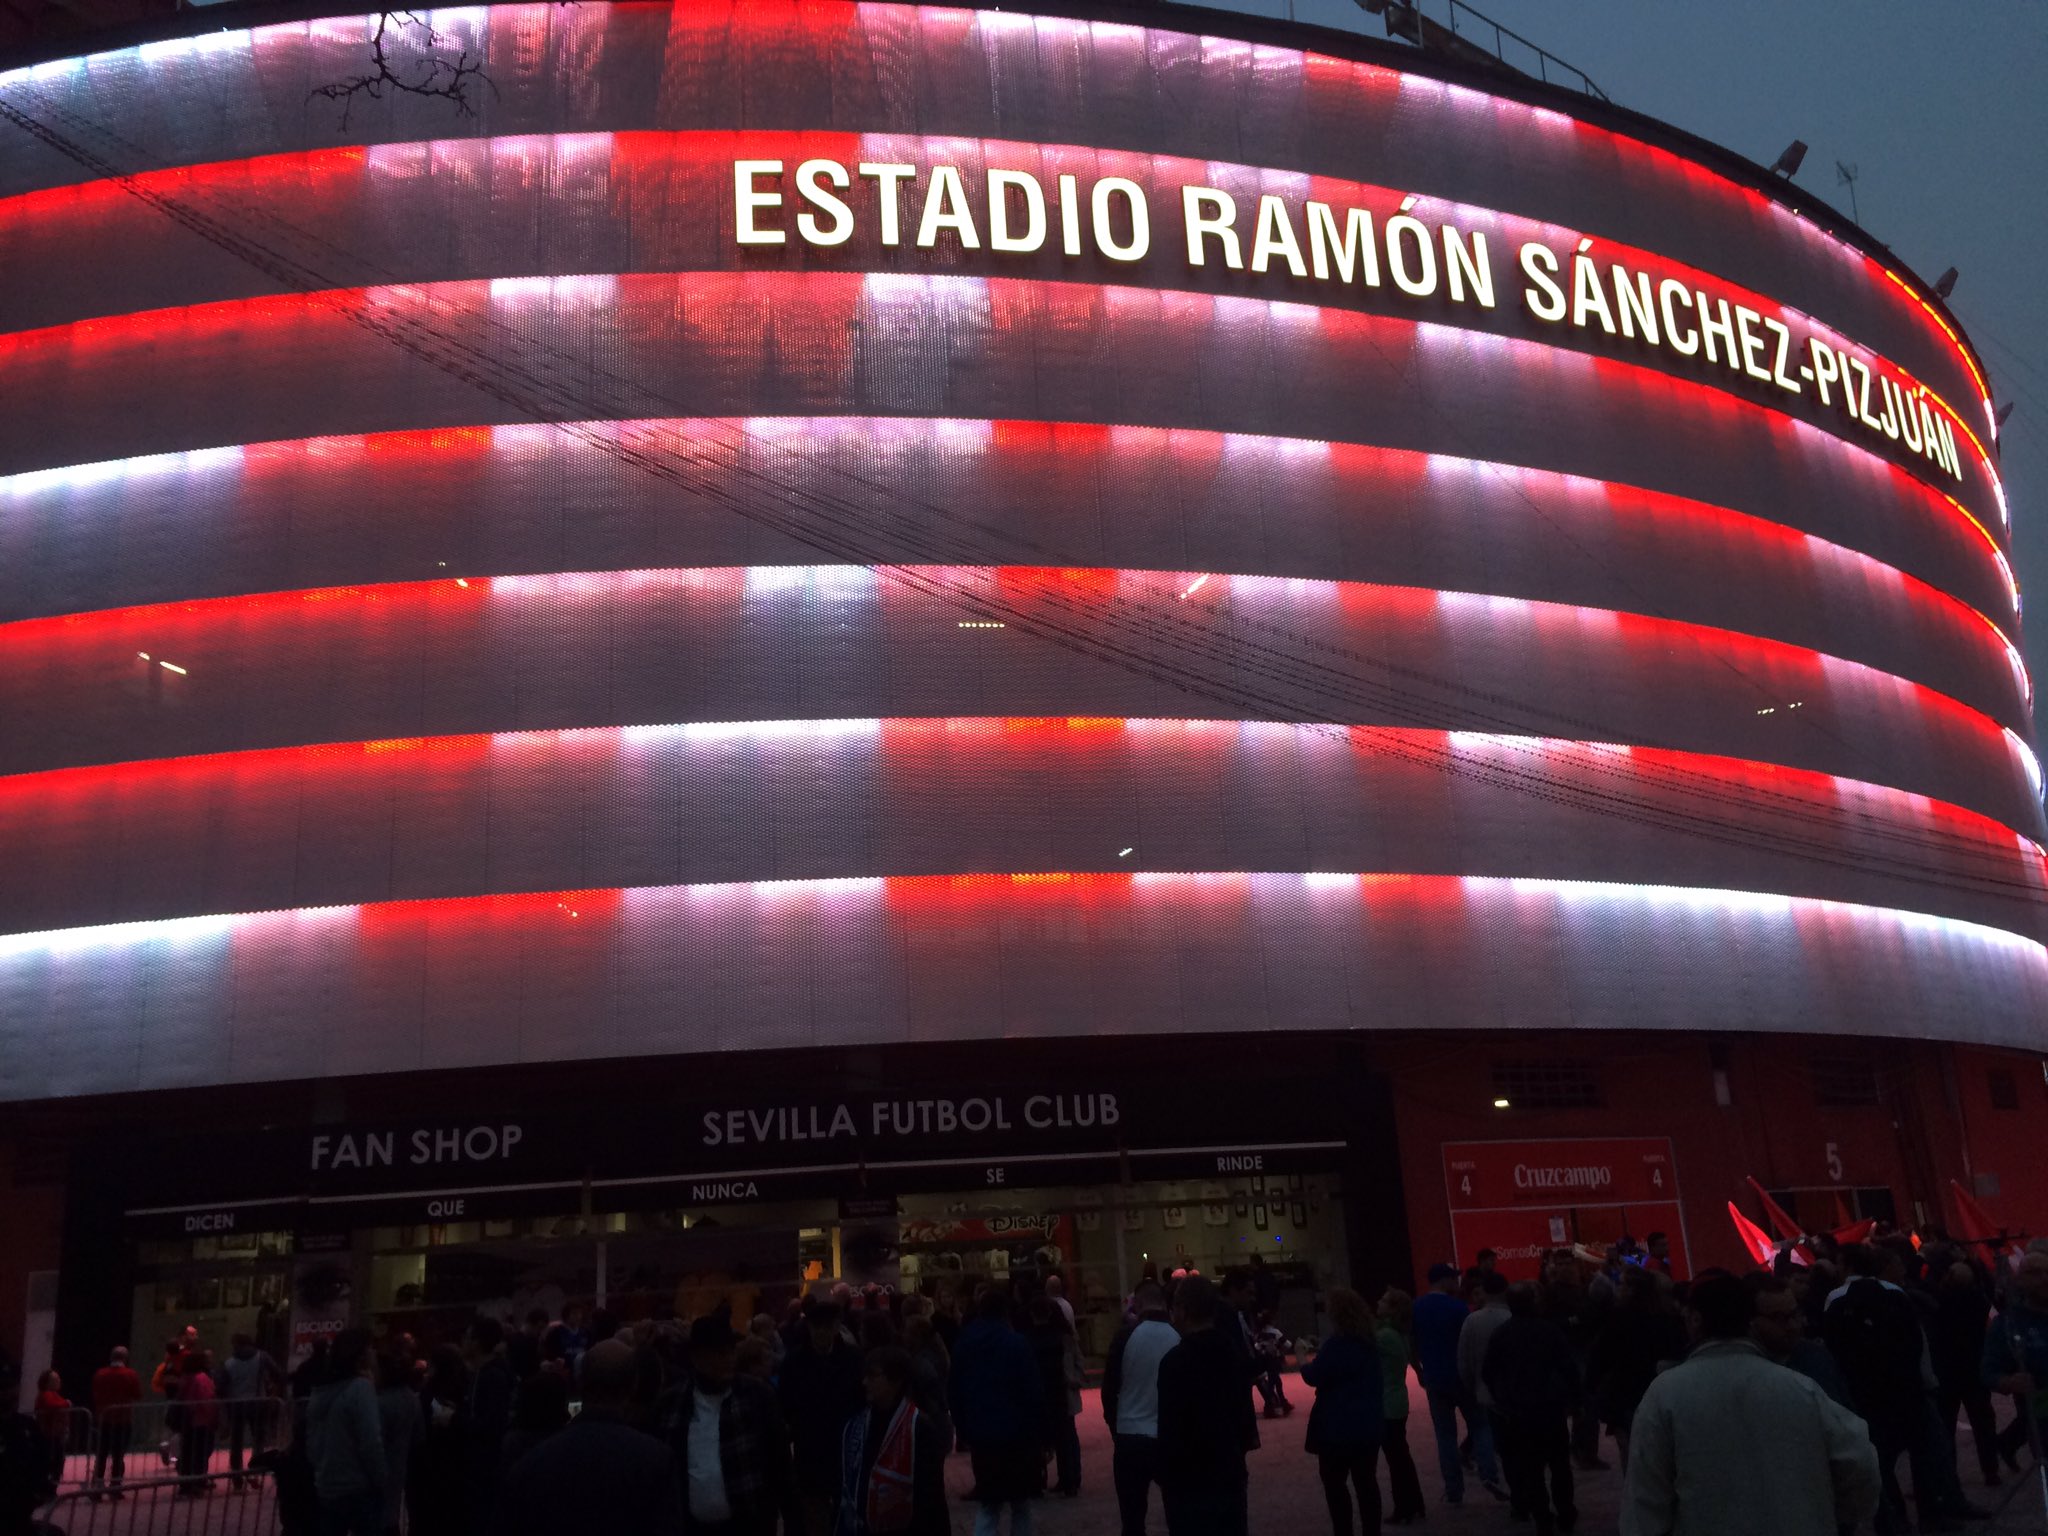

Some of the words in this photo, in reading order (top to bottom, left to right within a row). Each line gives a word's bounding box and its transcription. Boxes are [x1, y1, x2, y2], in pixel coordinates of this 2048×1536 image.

[734, 158, 1151, 263] ESTADIO
[1181, 184, 1496, 309] RAMÓN
[1520, 238, 1963, 482] SÁNCHEZ-PIZJUÁN
[702, 1103, 857, 1147] SEVILLA
[871, 1096, 1011, 1136] FUTBOL
[1024, 1092, 1120, 1128] CLUB
[310, 1131, 394, 1171] FAN
[409, 1124, 524, 1165] SHOP
[1216, 1155, 1264, 1173] RINDE
[1825, 1142, 1844, 1182] 5
[985, 1168, 1006, 1185] SE
[1460, 1175, 1473, 1196] 4
[1513, 1163, 1612, 1191] Cruzcampo
[1652, 1168, 1663, 1189] 4
[691, 1181, 759, 1202] NUNCA
[426, 1199, 466, 1219] QUE
[184, 1212, 236, 1233] DICEN
